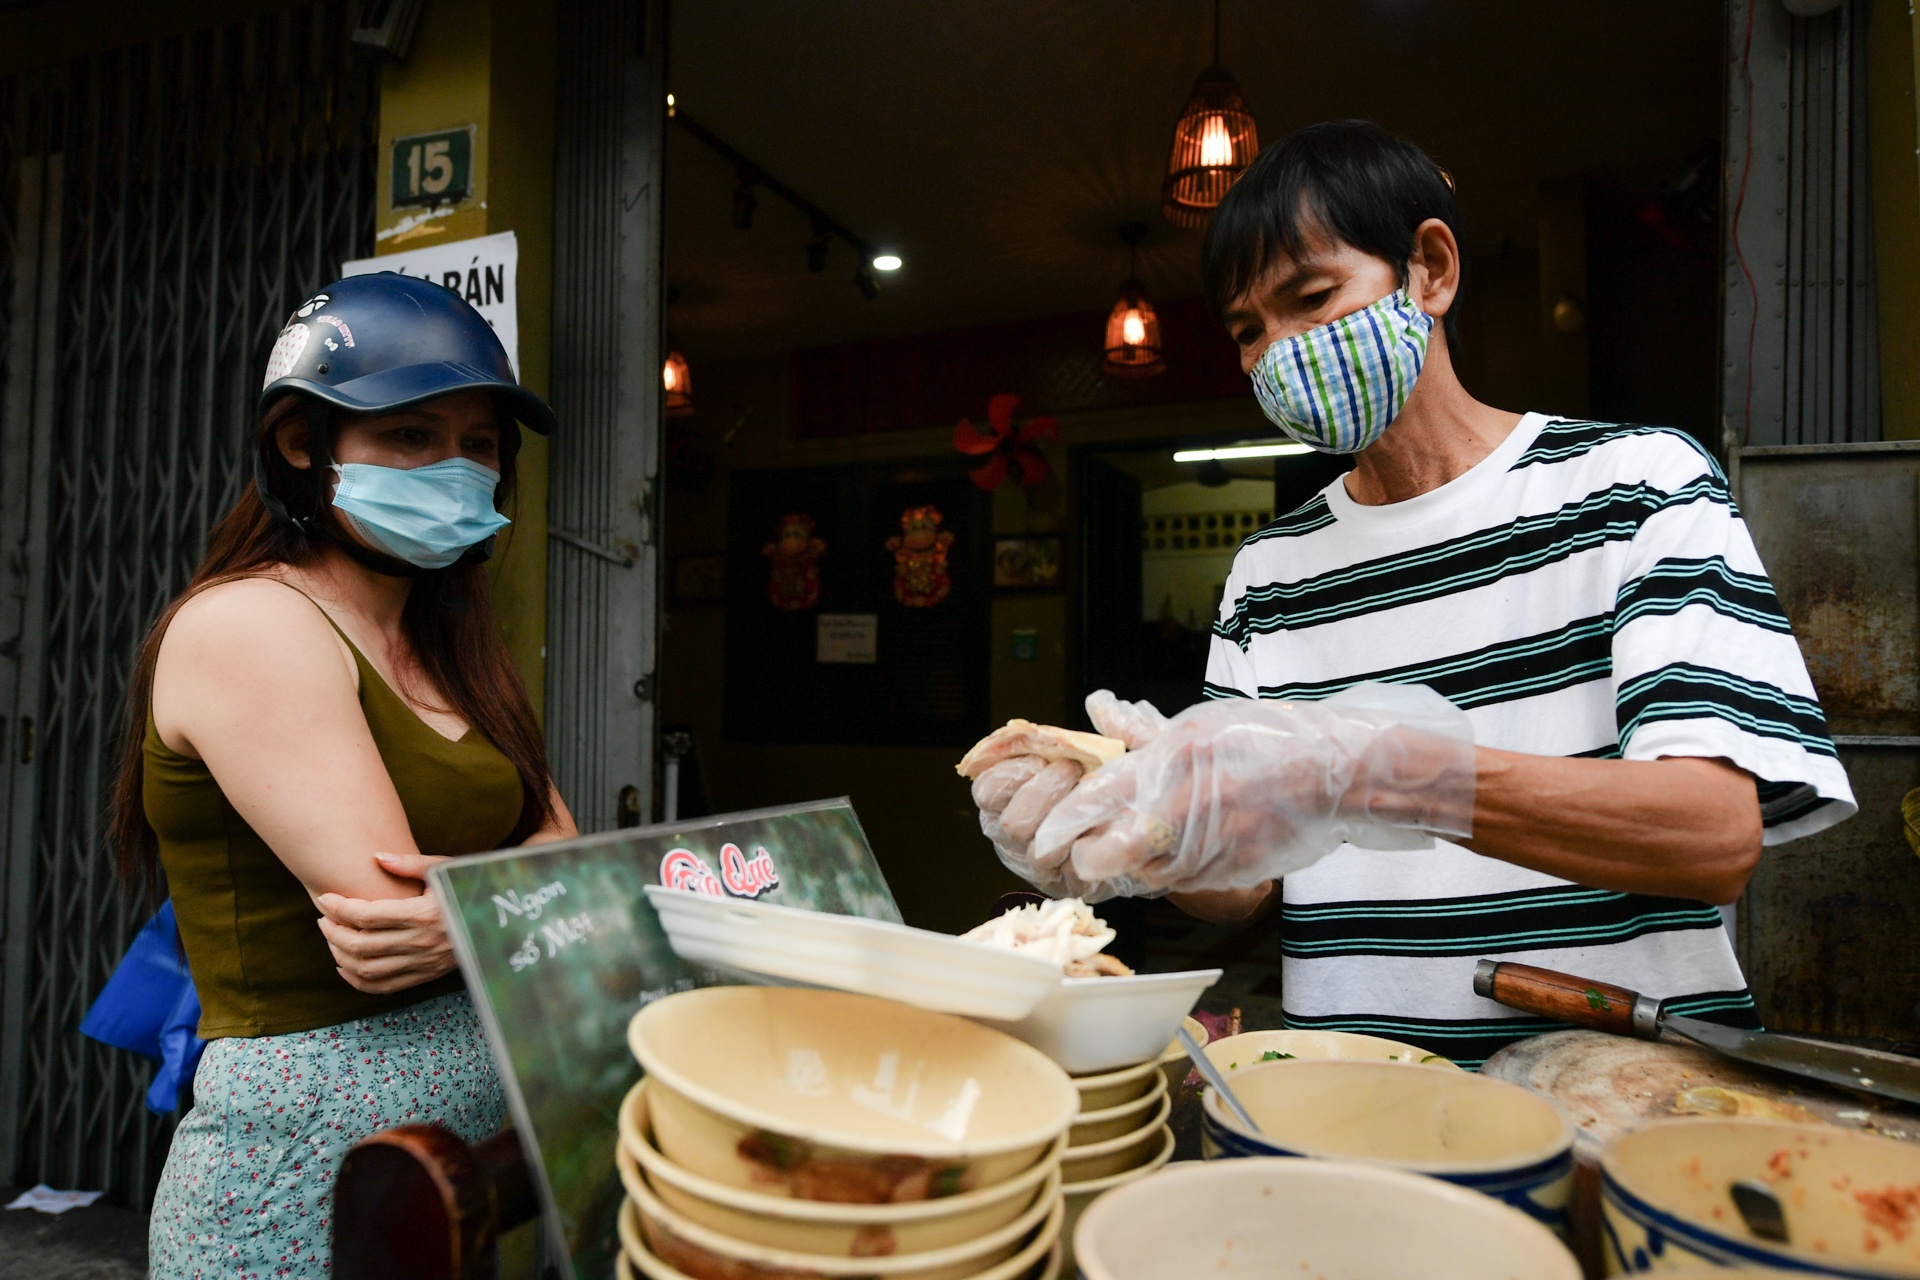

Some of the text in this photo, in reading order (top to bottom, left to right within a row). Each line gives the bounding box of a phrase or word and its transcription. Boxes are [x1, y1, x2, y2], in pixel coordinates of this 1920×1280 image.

[407, 140, 454, 197] 15
[443, 256, 504, 307] BÁN
[491, 881, 567, 928] Ngon
